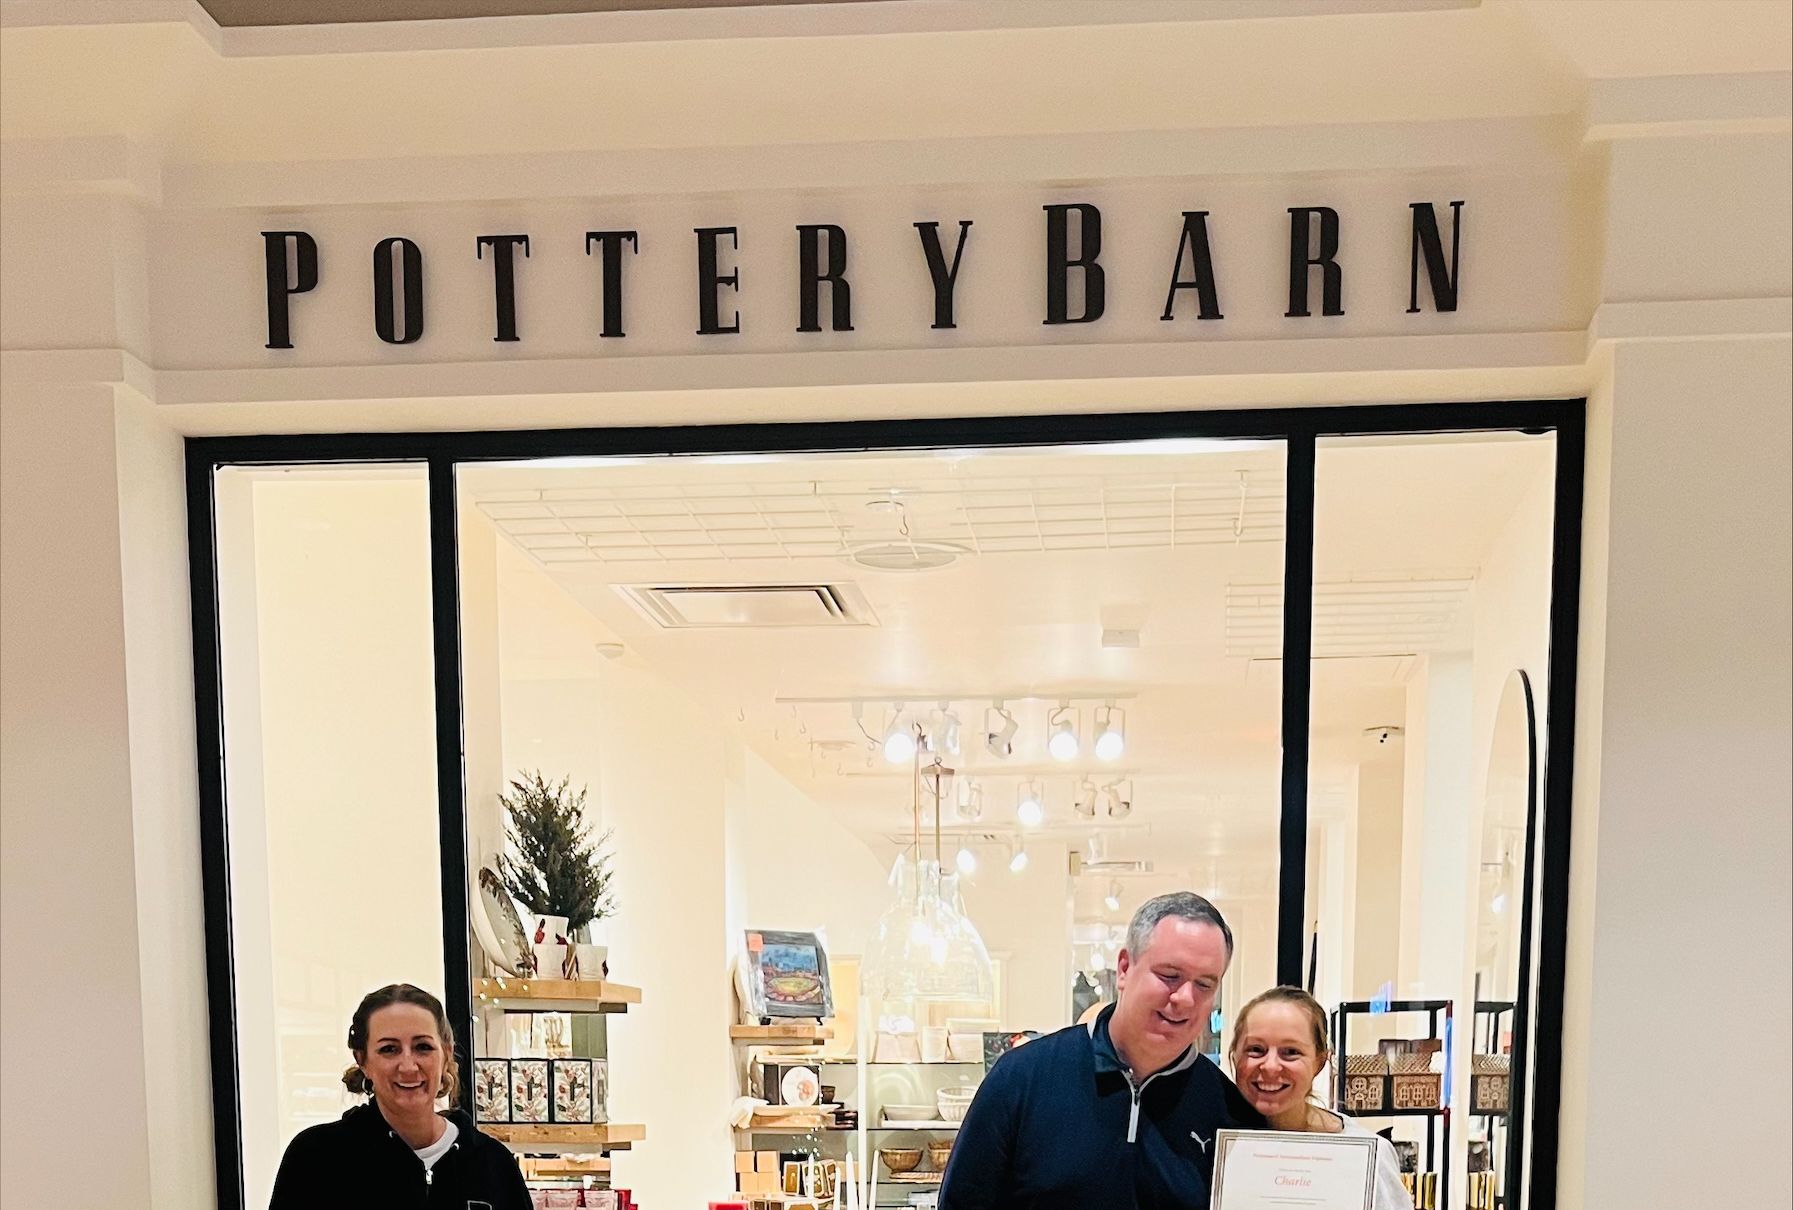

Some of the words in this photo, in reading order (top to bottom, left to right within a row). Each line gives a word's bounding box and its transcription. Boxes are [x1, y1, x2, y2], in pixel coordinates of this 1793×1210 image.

[260, 219, 974, 349] POTTERY
[1042, 200, 1466, 326] BARN
[1274, 1175, 1312, 1187] Charlie
